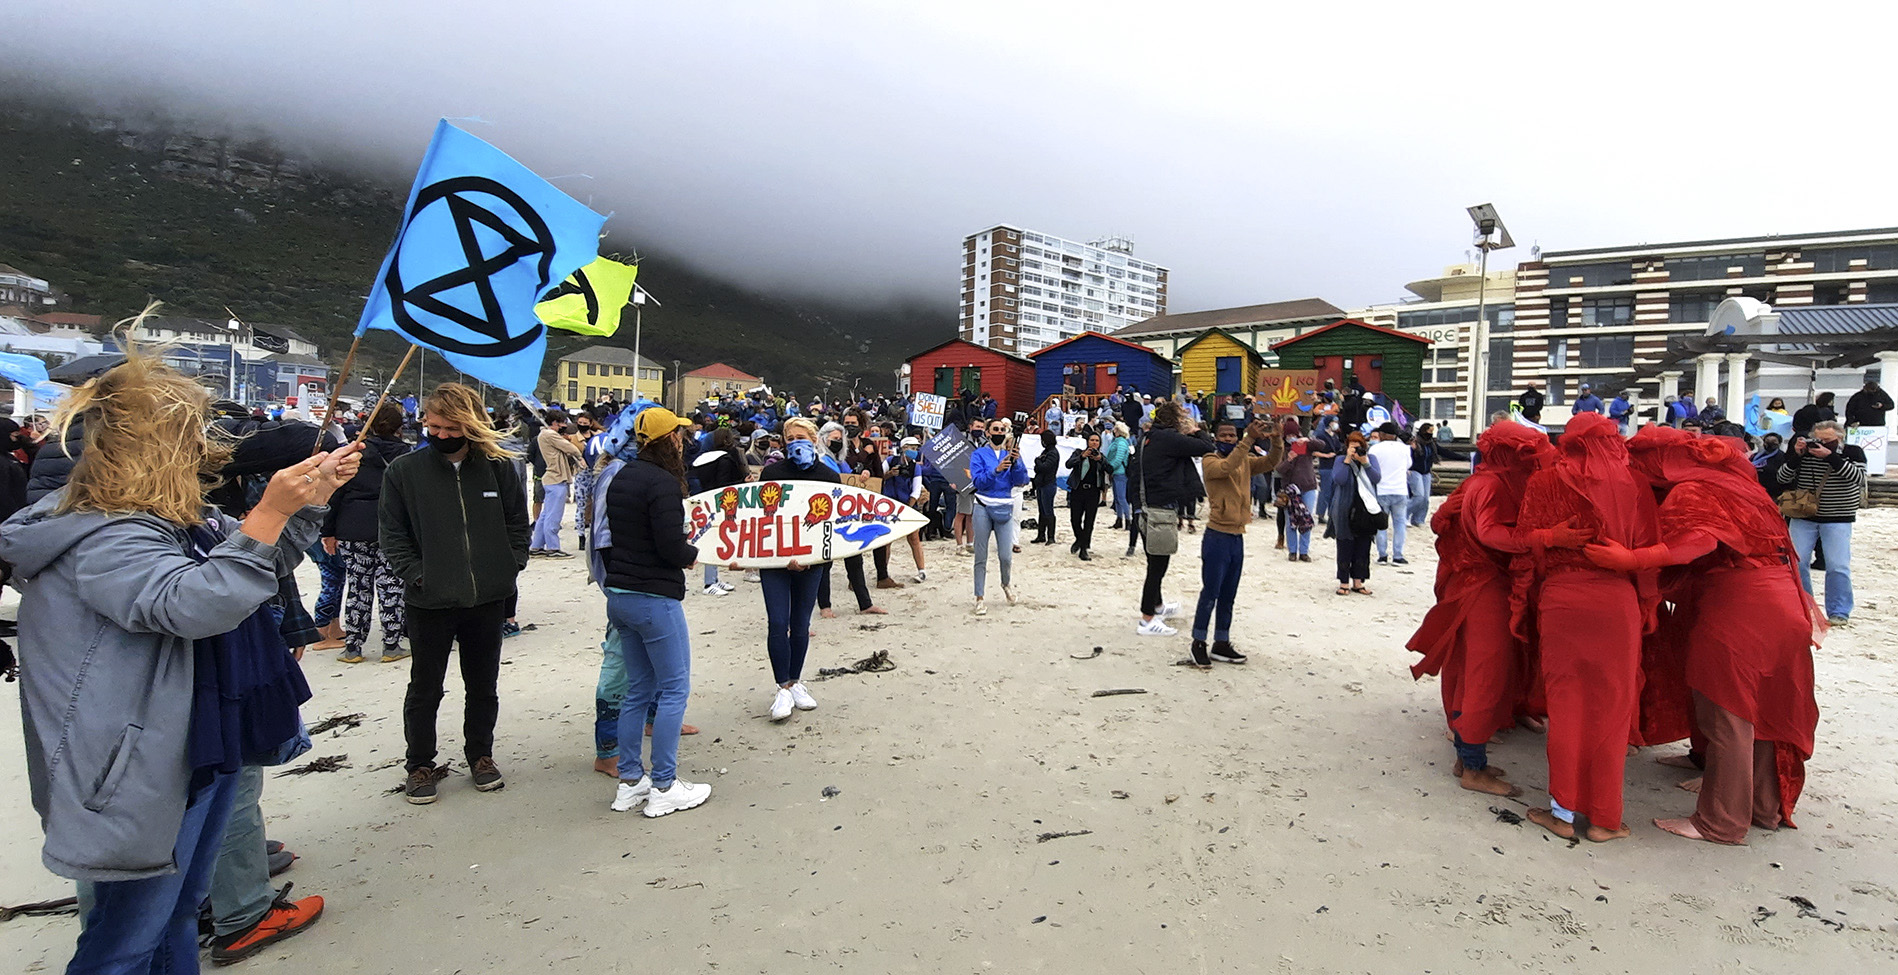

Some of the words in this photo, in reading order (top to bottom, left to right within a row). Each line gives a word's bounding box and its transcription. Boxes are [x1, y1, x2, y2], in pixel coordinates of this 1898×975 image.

[1262, 376, 1280, 387] NO
[1296, 376, 1314, 386] NO
[917, 400, 944, 415] SHELL
[913, 412, 926, 425] US
[931, 432, 945, 444] SAVE
[932, 435, 952, 452] OCEANS
[935, 440, 966, 465] LIVELIHOODS
[939, 442, 953, 454] SAVE
[716, 515, 812, 560] SHELL
